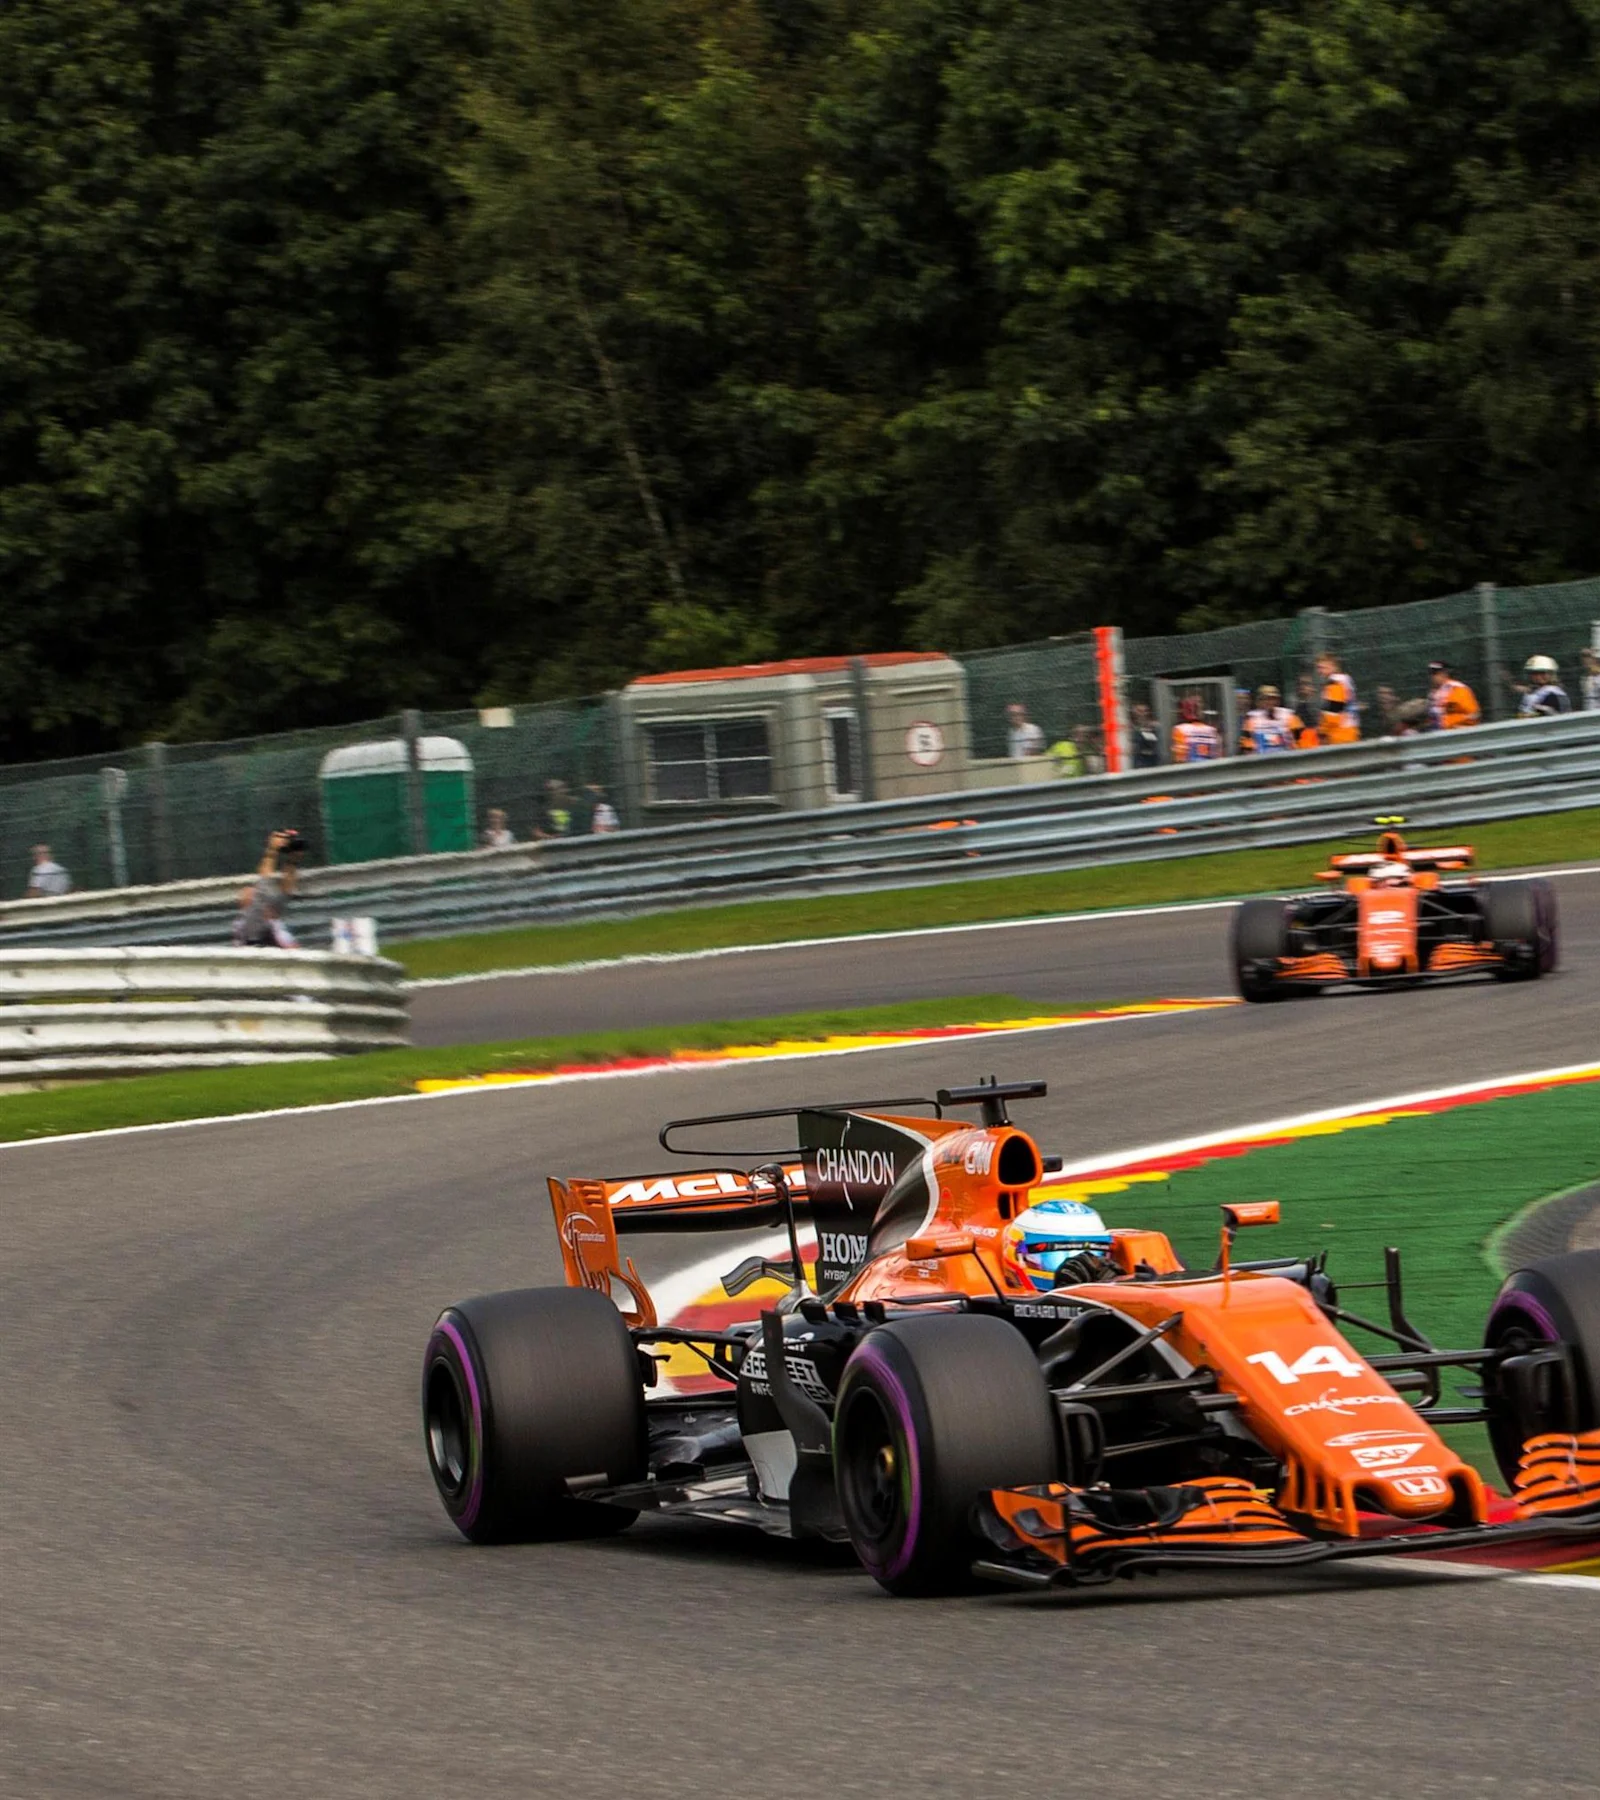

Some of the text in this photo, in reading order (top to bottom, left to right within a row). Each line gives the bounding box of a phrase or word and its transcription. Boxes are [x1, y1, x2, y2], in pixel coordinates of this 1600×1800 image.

[816, 1147, 895, 1185] CHANDON
[1014, 1304, 1055, 1318] RICHARD
[1245, 1345, 1365, 1384] 14
[1358, 1448, 1408, 1464] SAP
